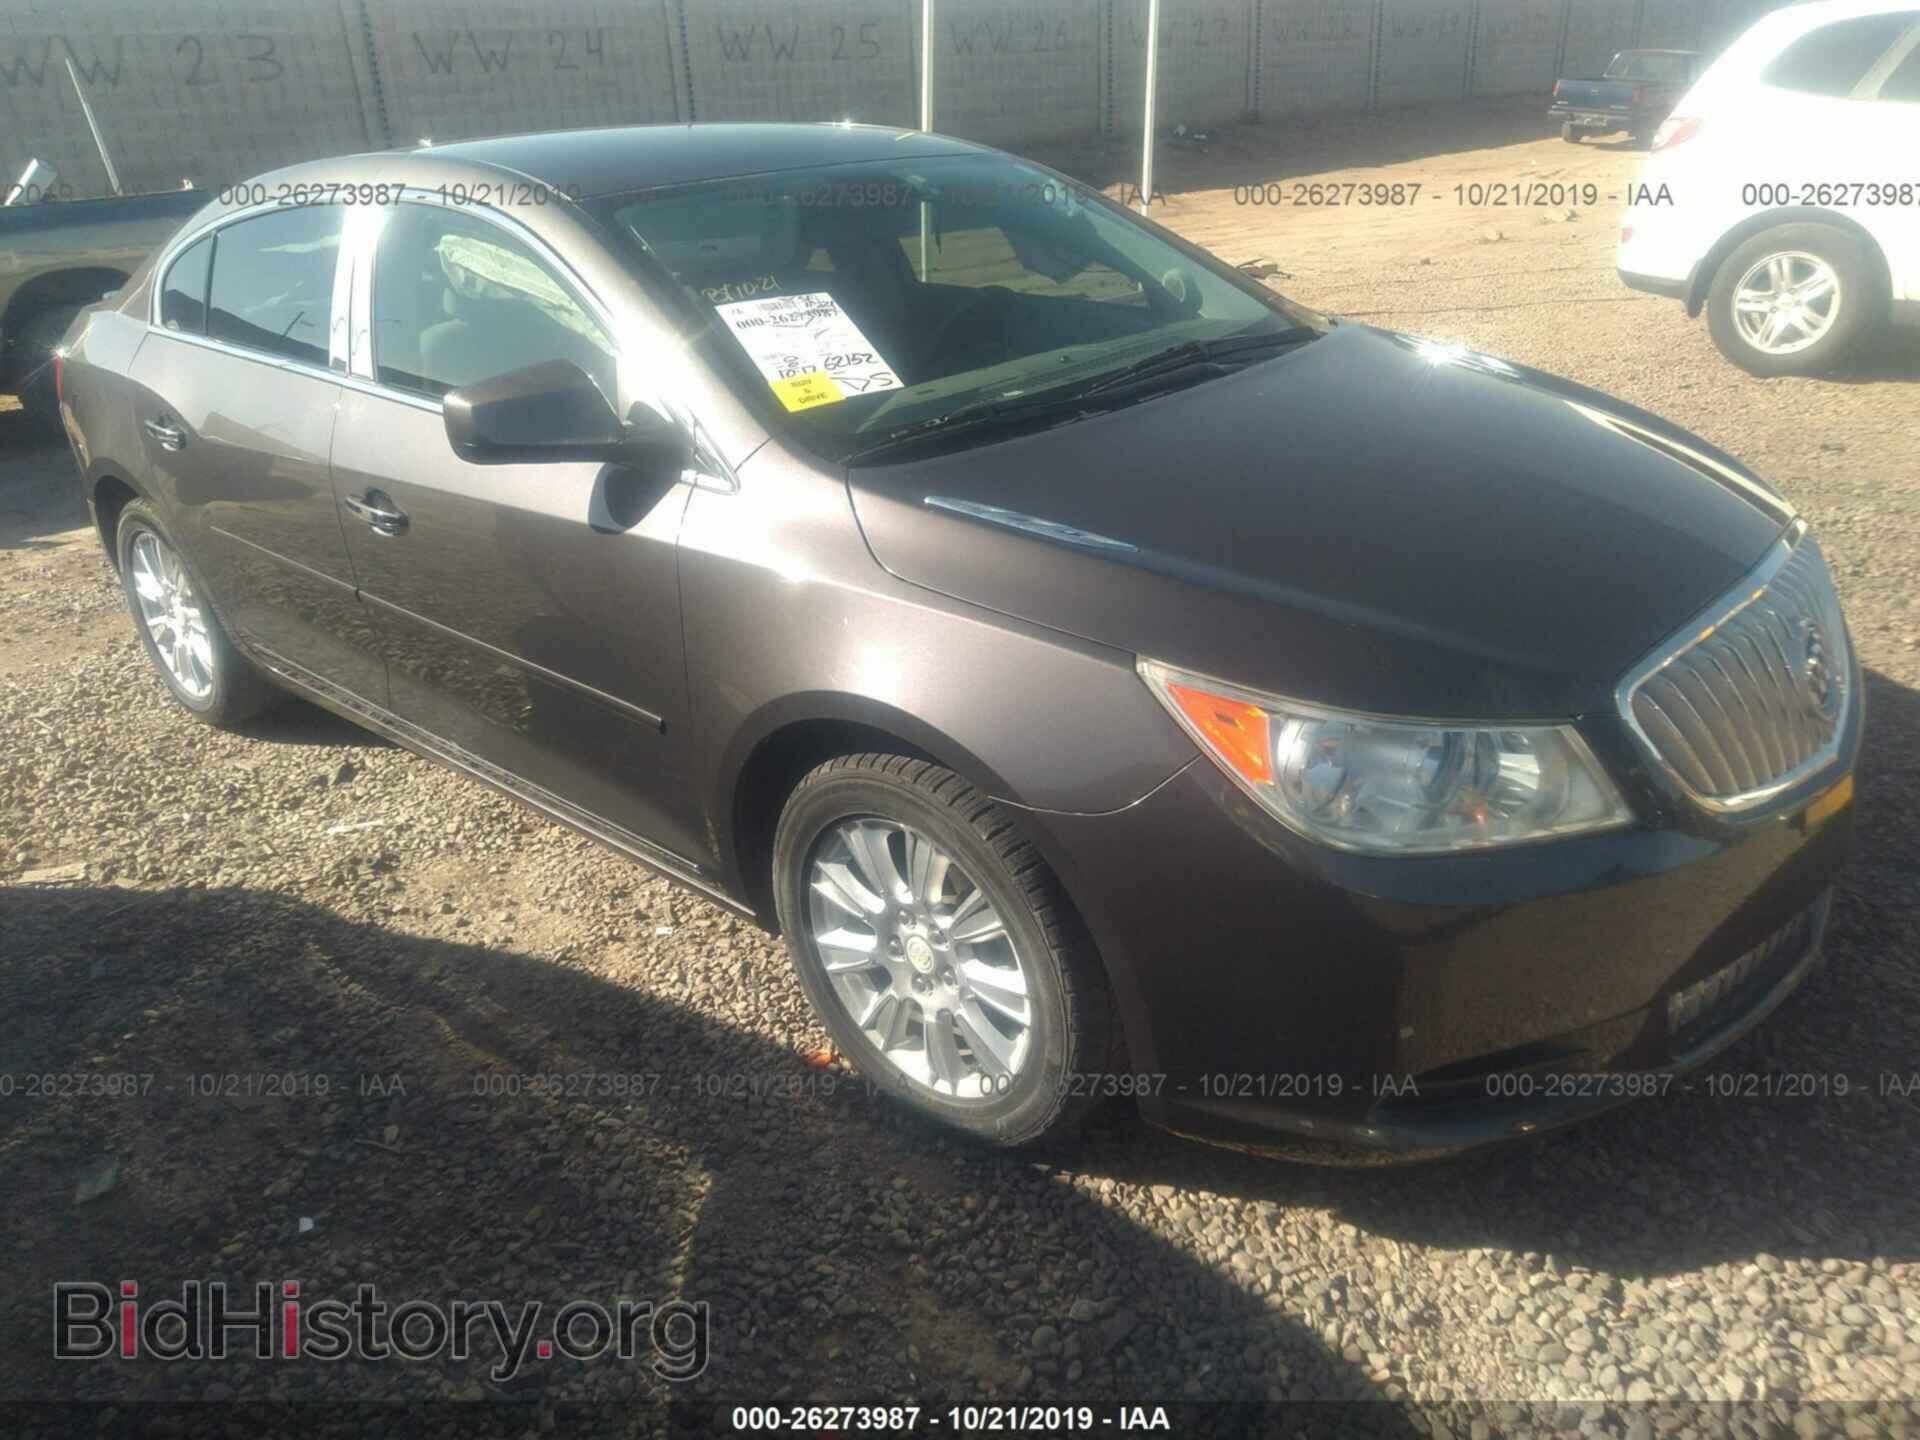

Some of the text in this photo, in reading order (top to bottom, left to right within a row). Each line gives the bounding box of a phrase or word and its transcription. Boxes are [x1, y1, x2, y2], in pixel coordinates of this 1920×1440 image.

[413, 30, 605, 74] WW 24
[718, 22, 881, 62] WW 25
[824, 352, 880, 370] 62152
